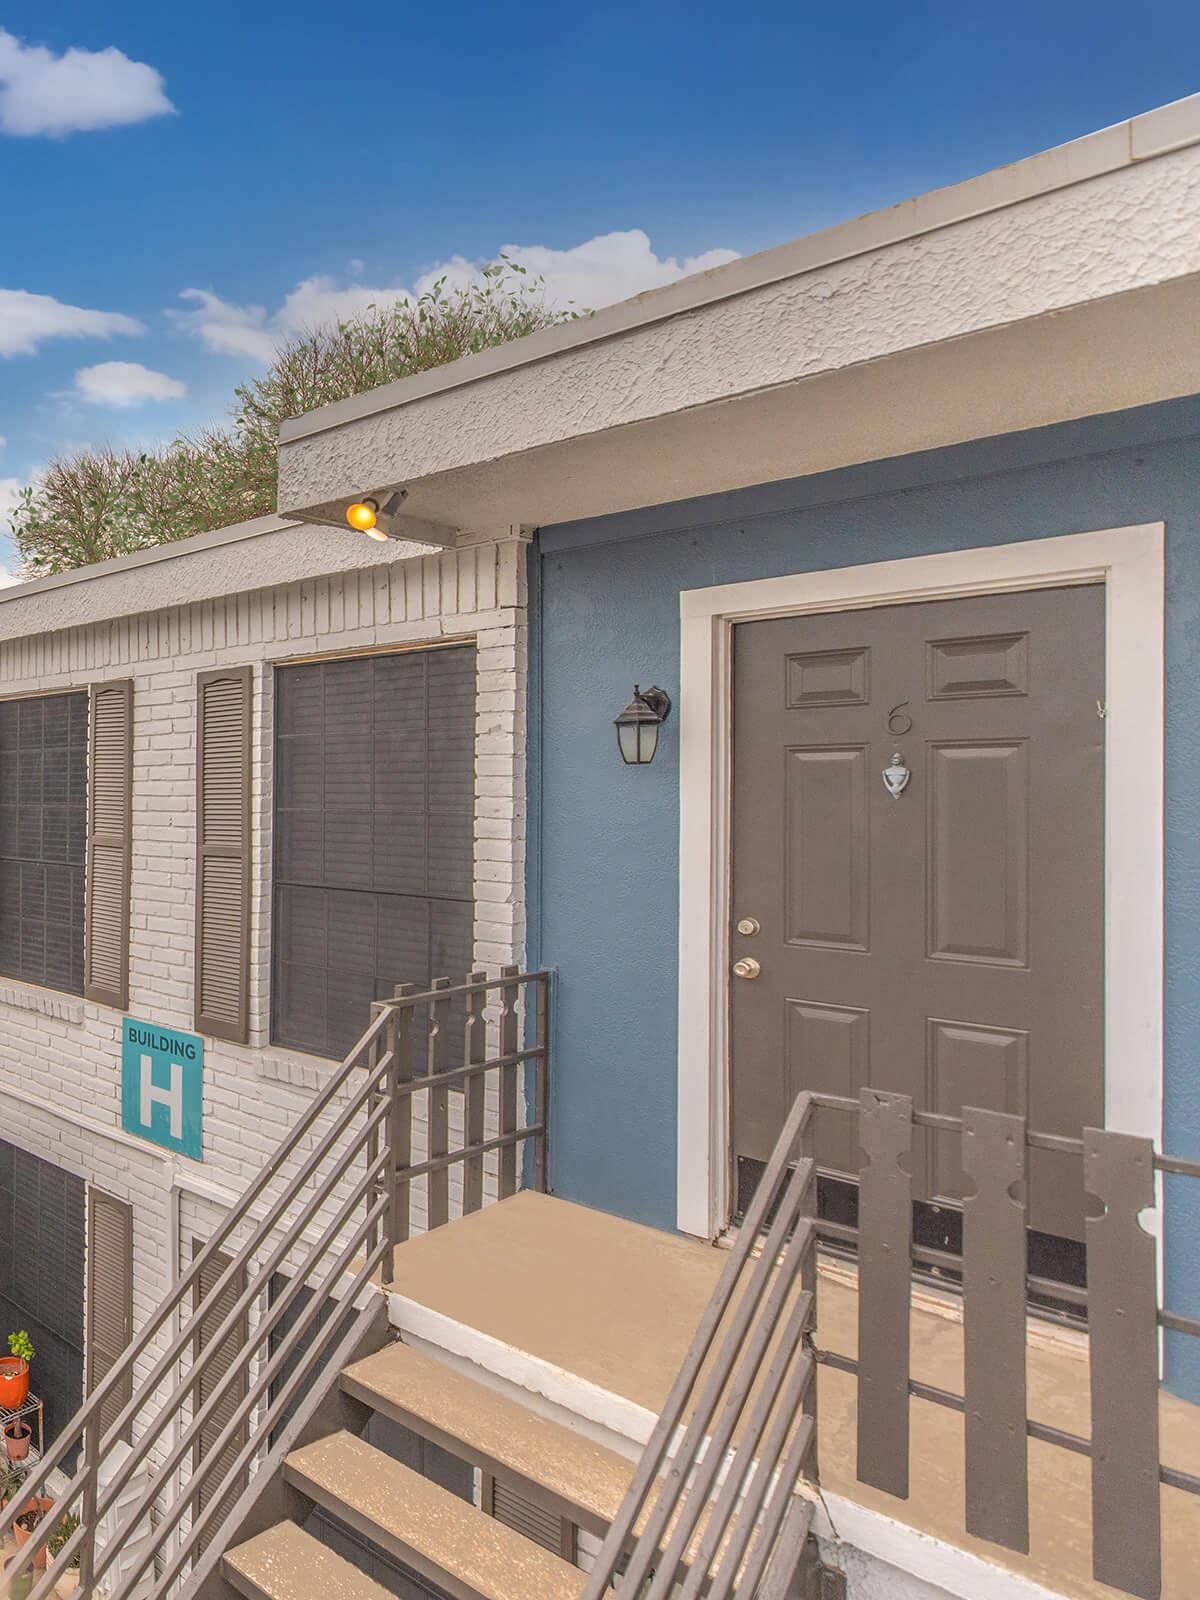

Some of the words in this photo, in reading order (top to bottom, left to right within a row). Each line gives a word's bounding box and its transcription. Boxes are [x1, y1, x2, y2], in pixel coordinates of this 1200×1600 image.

[888, 701, 912, 735] 6
[129, 1027, 196, 1060] BUILDING
[140, 1054, 183, 1140] H
